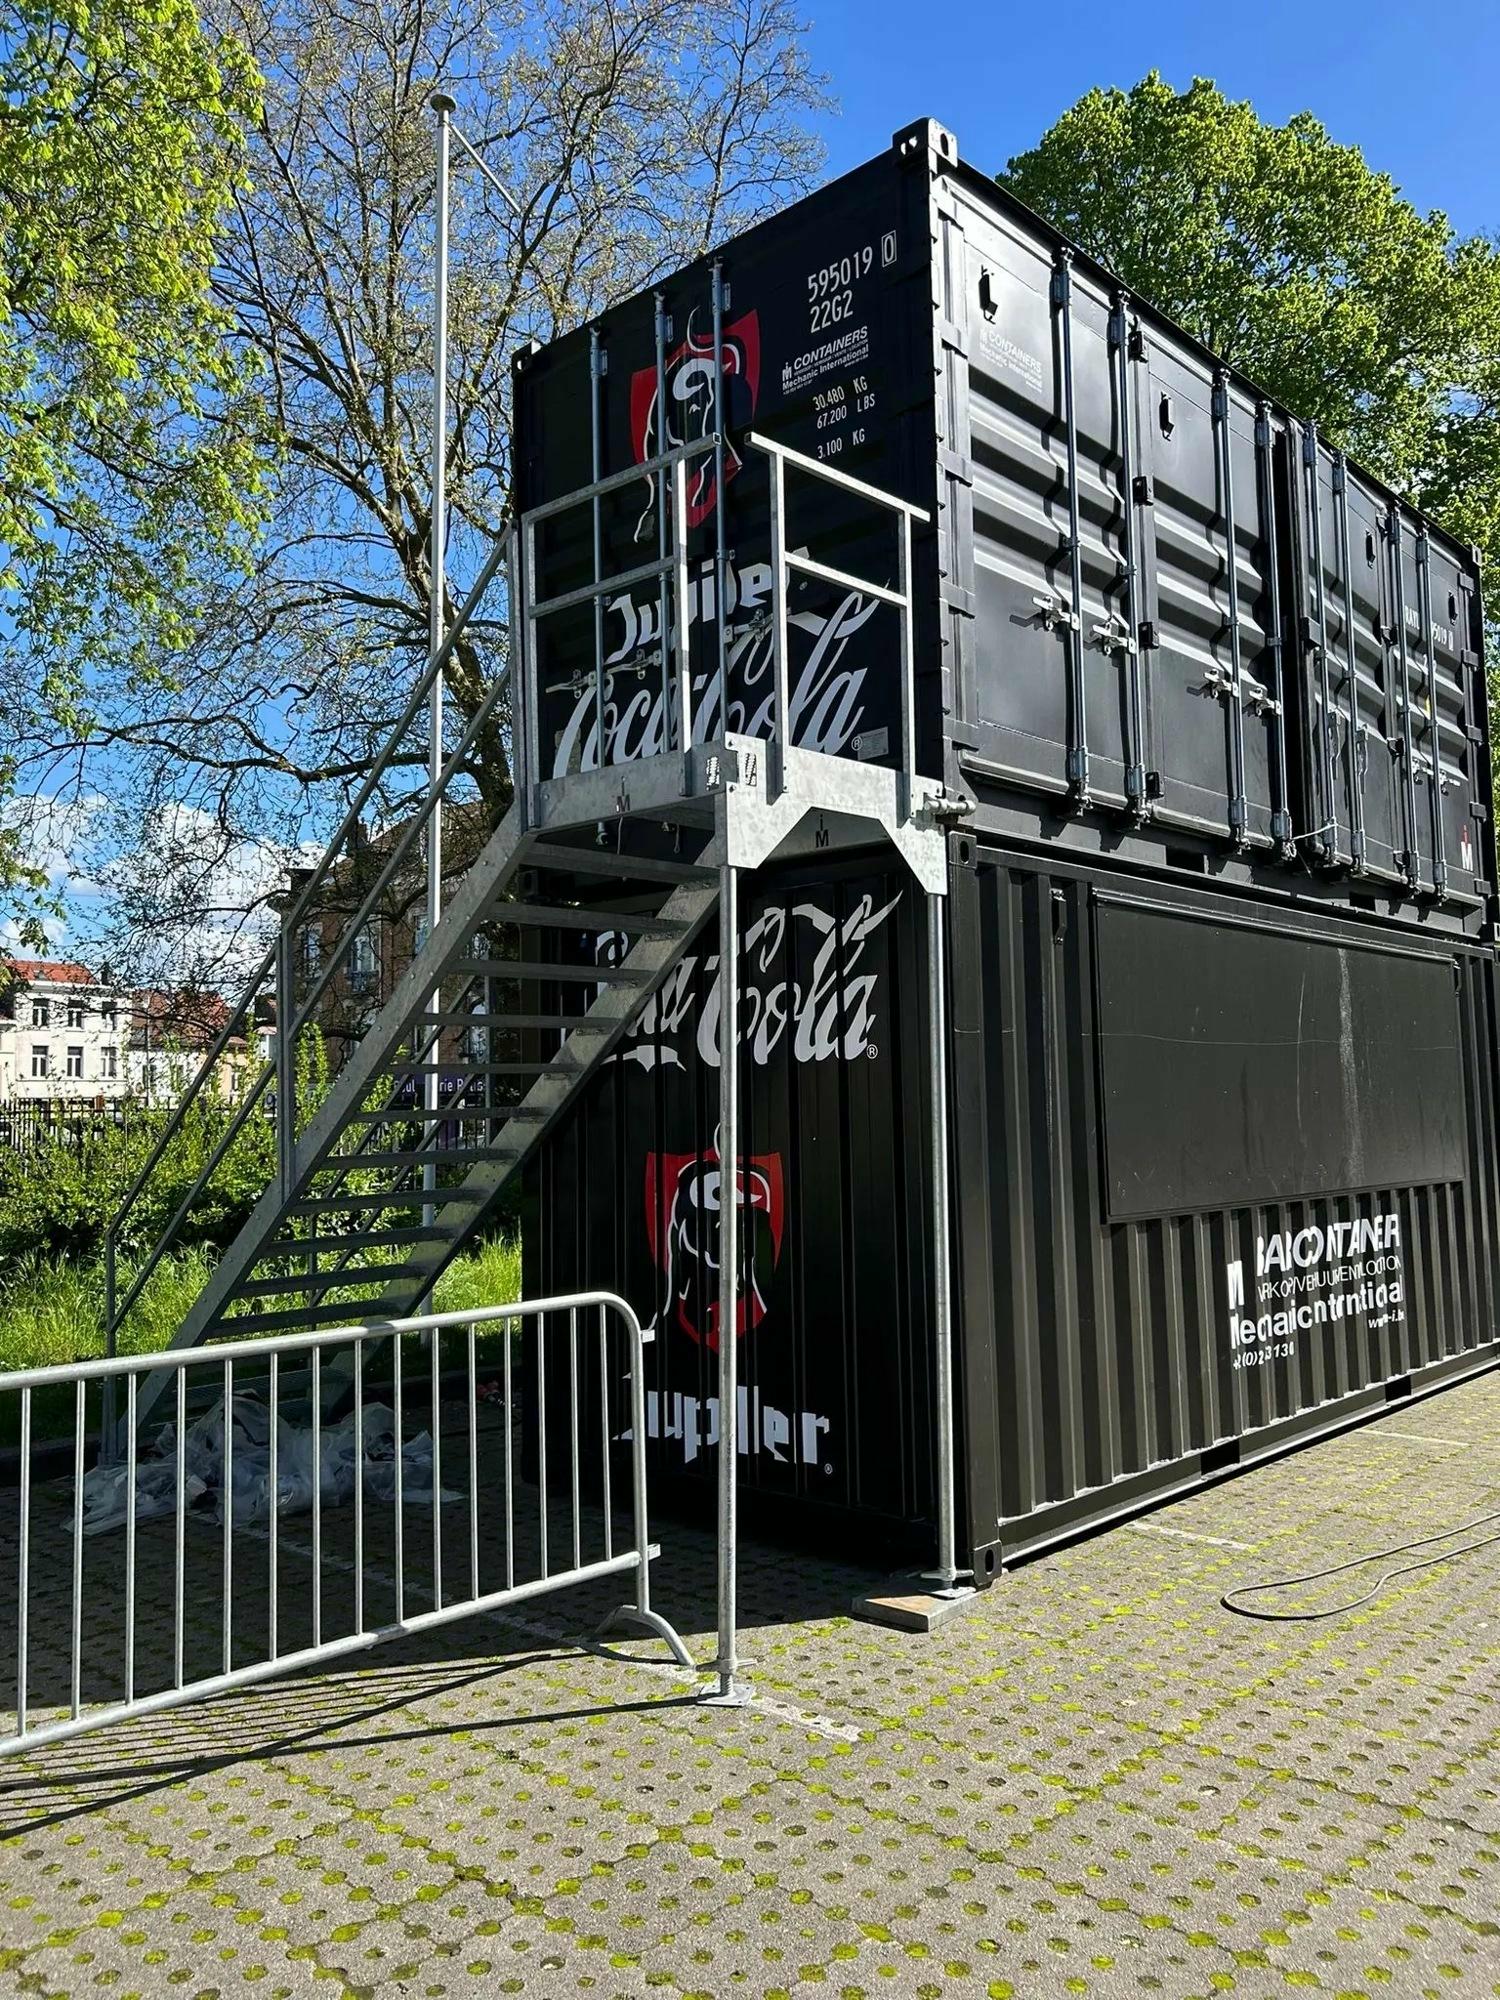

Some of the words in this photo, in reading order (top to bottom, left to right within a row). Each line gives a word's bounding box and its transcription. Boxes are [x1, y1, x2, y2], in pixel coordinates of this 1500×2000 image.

[808, 246, 873, 303] 595019
[883, 232, 896, 266] 0
[810, 289, 854, 334] 22G2
[782, 369, 818, 391] Mechanic
[819, 343, 869, 374] International
[793, 325, 868, 370] CONTAINERS
[812, 385, 845, 411] 30.480
[852, 375, 868, 394] KG
[816, 405, 847, 430] 67.200
[857, 393, 876, 413] LBS
[817, 437, 843, 460] 3.100
[852, 428, 866, 446] KG
[604, 547, 809, 665] Juile
[560, 890, 903, 1072] a-Cola
[1292, 1213, 1400, 1268] CONTANER
[612, 1372, 830, 1465] Jupler
